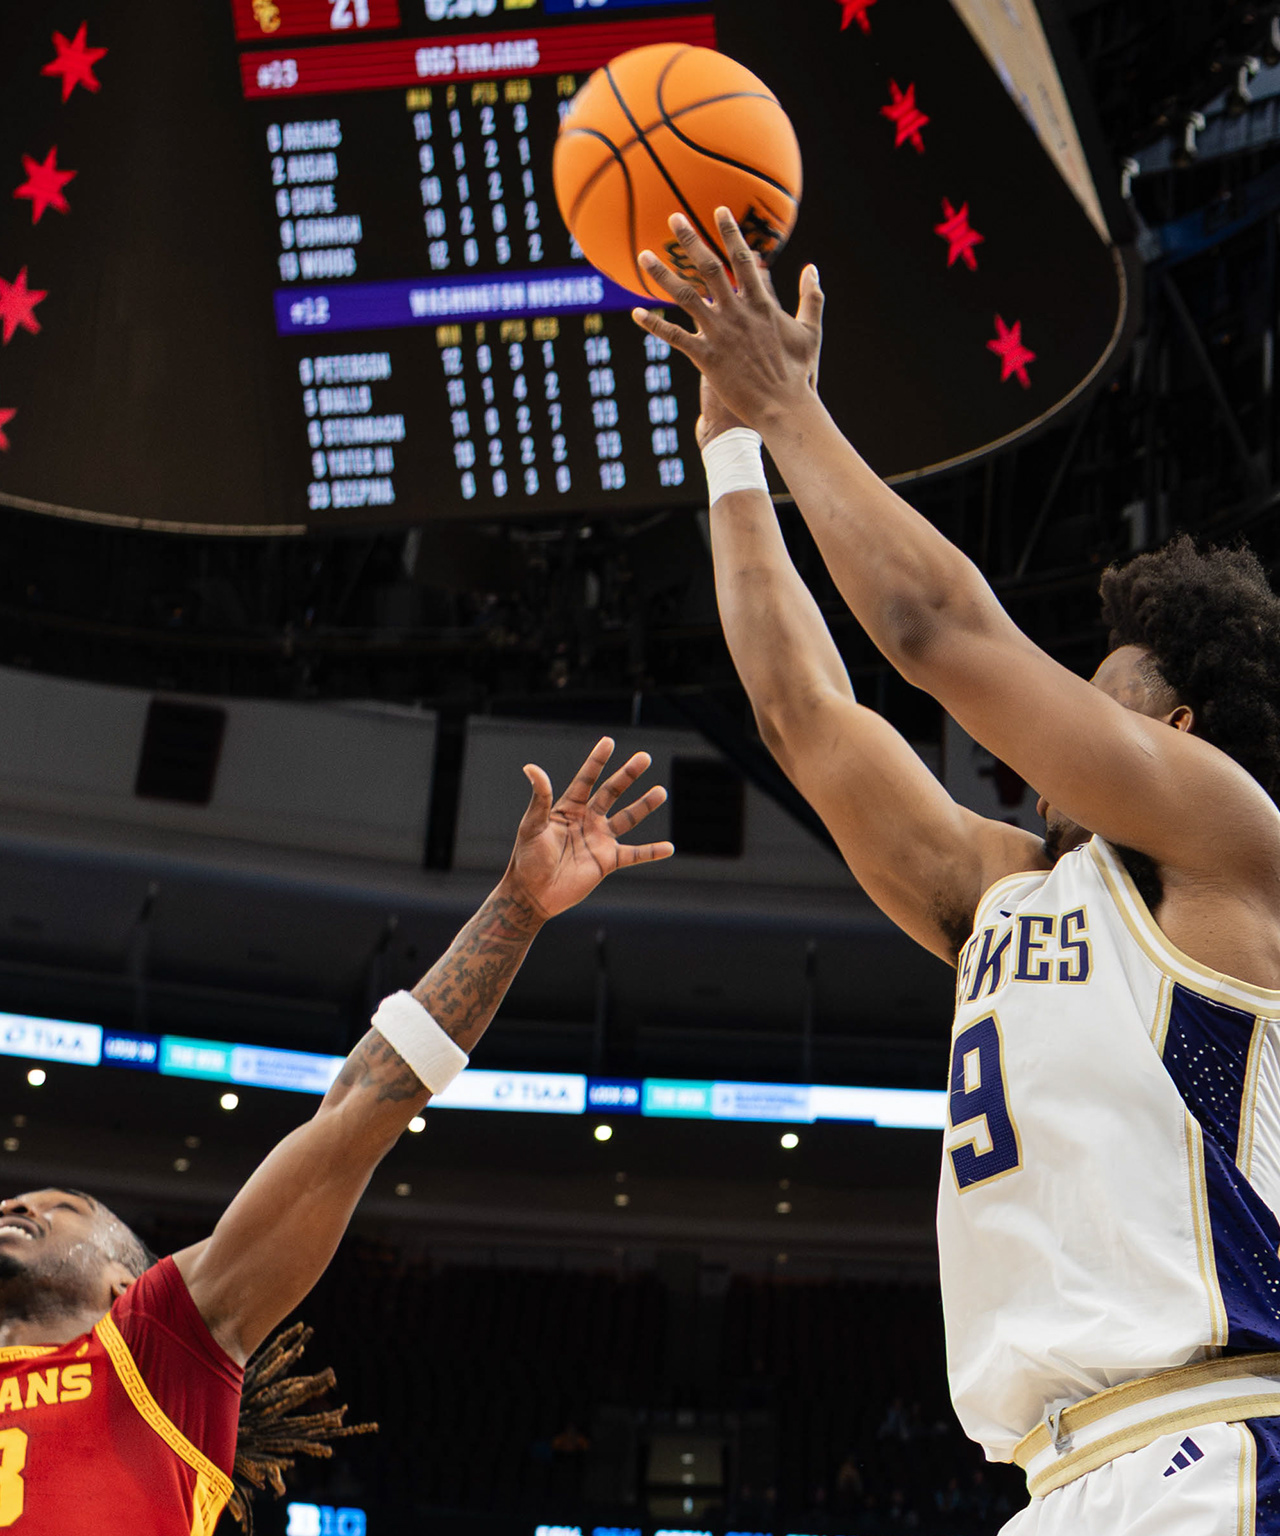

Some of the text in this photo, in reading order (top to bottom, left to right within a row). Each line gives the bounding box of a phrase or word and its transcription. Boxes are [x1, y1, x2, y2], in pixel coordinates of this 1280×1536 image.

[479, 106, 496, 136] 2
[271, 156, 287, 186] 2
[483, 139, 500, 168] 2
[488, 171, 504, 201] 2
[459, 205, 476, 236] 2
[524, 200, 540, 231] 2
[528, 232, 544, 262] 2
[544, 371, 560, 400] 2
[947, 1008, 1024, 1196] 9
